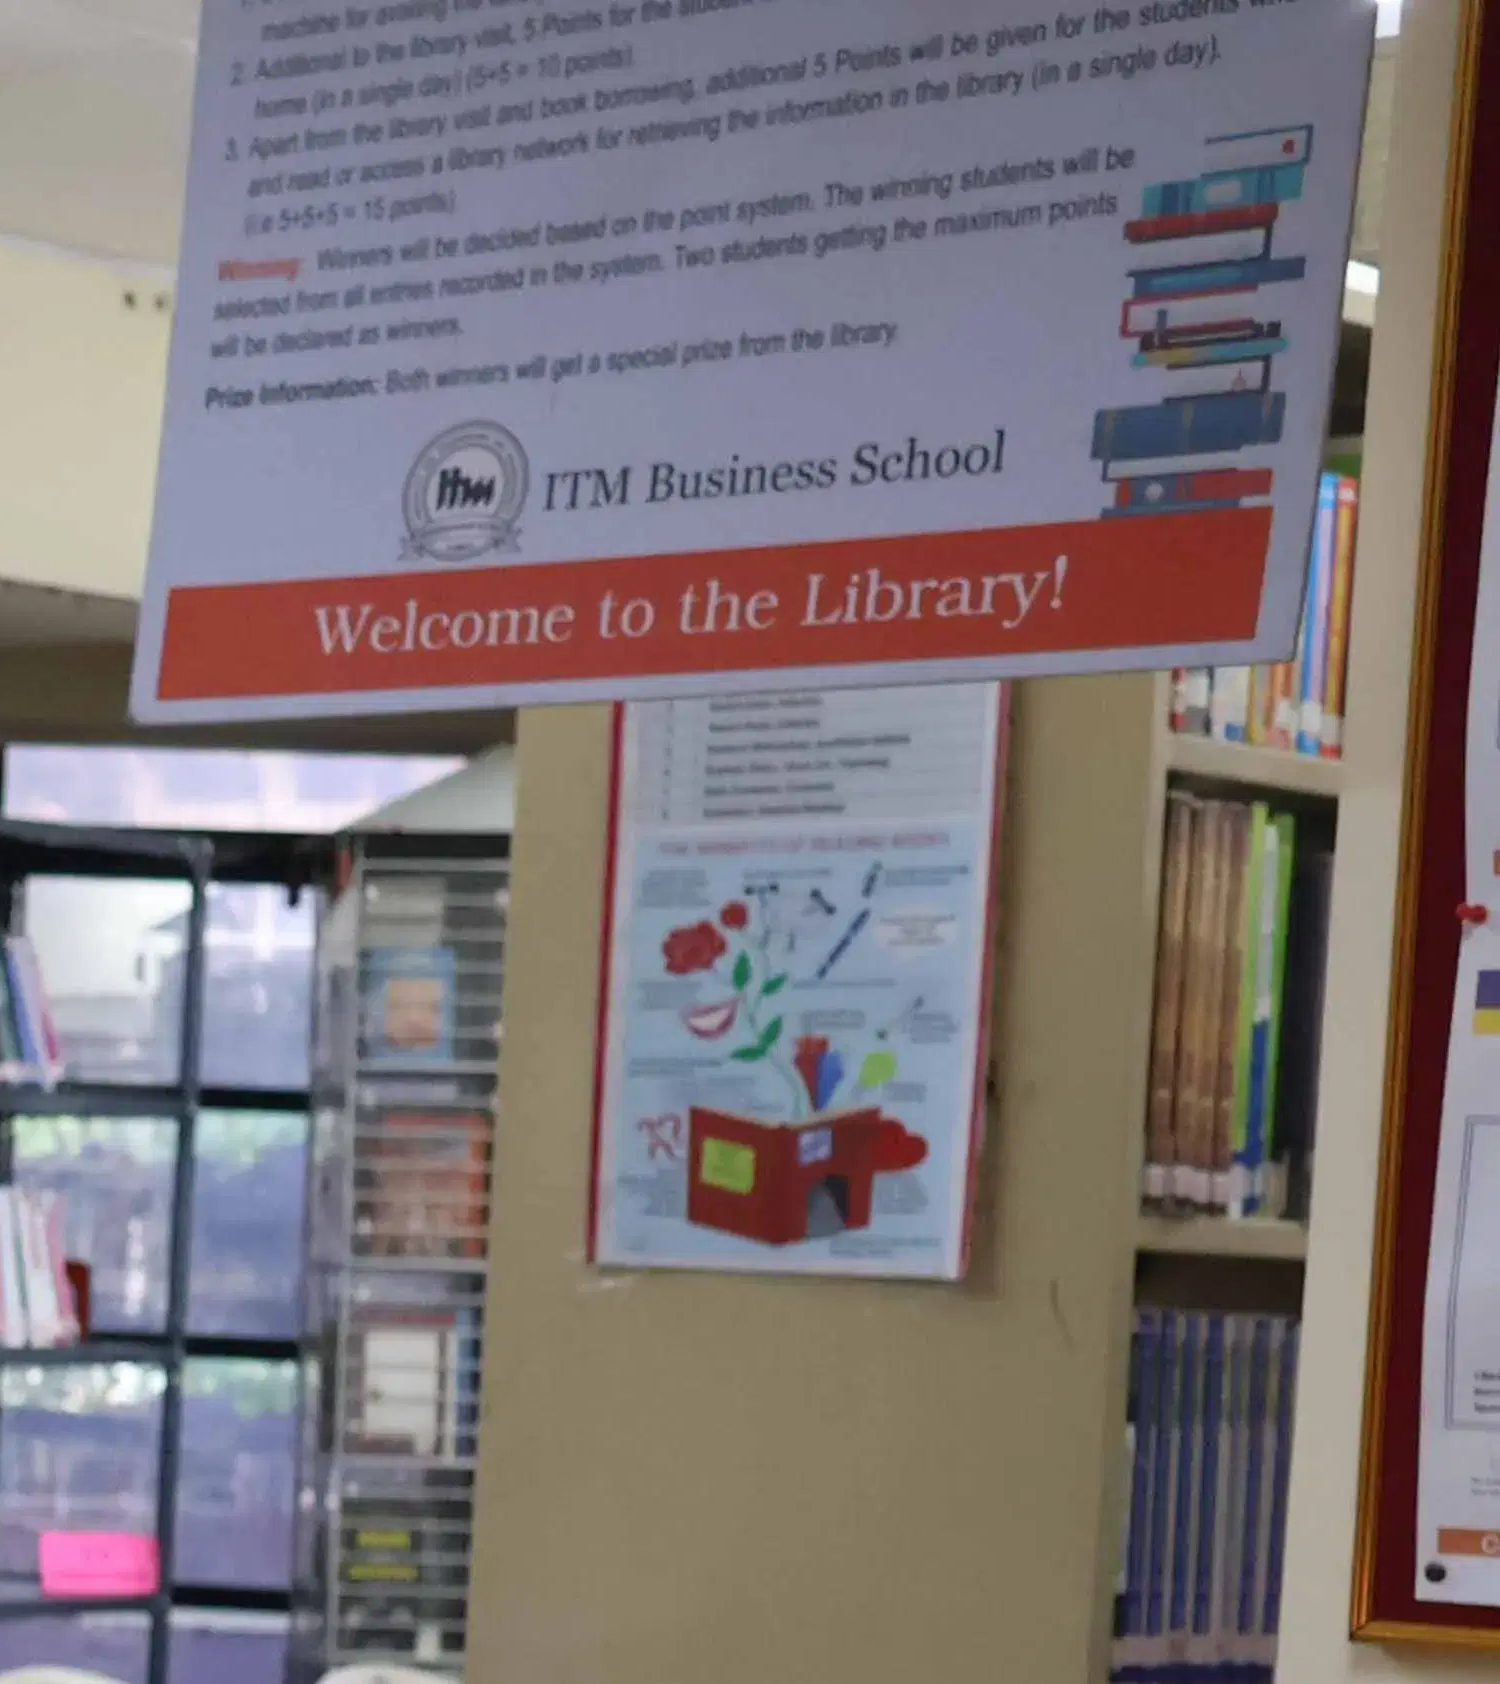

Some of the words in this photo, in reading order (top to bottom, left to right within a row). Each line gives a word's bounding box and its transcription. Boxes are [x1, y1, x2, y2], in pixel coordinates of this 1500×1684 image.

[376, 41, 405, 65] the
[409, 33, 469, 61] library
[524, 17, 539, 41] 5
[609, 4, 636, 27] for
[247, 173, 283, 199] and
[335, 167, 353, 186] or
[431, 155, 443, 174] a
[447, 144, 506, 173] library
[513, 131, 589, 162] network
[594, 126, 622, 151] for
[628, 115, 721, 145] retrieving
[726, 107, 758, 132] the
[765, 89, 884, 126] information
[888, 85, 909, 108] in
[915, 77, 950, 104] the
[956, 69, 1024, 98] library
[1031, 59, 1061, 92] (in
[1066, 60, 1082, 83] a
[1088, 46, 1157, 80] single
[248, 132, 299, 160] Apart
[305, 127, 347, 151] from
[352, 121, 385, 145] the
[388, 114, 447, 141] library
[453, 104, 492, 131] visit
[495, 99, 534, 125] and
[539, 92, 589, 120] book
[706, 57, 807, 95] additional
[813, 52, 827, 78] 5
[835, 45, 902, 74] Points
[909, 33, 944, 61] will
[951, 30, 979, 57] be
[986, 22, 1047, 57] given
[1055, 12, 1086, 40] for
[1093, 6, 1131, 35] the
[316, 244, 393, 271] Winners
[399, 237, 430, 262] will
[434, 235, 459, 259] be
[464, 223, 541, 256] decided
[545, 215, 606, 245] based
[611, 214, 638, 237] on
[643, 207, 675, 233] the
[679, 200, 731, 232] point
[823, 181, 864, 208] The
[870, 169, 953, 203] winning
[958, 157, 1056, 192] students
[1061, 148, 1099, 175] will
[1104, 144, 1136, 170] be
[363, 196, 386, 222] 15
[212, 296, 292, 320] selected
[296, 290, 339, 313] from
[369, 279, 434, 302] entries
[438, 267, 525, 296] recorded
[529, 264, 549, 286] in
[553, 259, 584, 283] the
[674, 244, 716, 270] Two
[720, 232, 808, 265] students
[813, 221, 887, 258] getting
[892, 216, 928, 242] the
[933, 203, 1043, 235] maximum
[1047, 191, 1118, 226] points
[204, 385, 255, 411] Prize
[385, 368, 431, 394] Both
[434, 363, 510, 388] winners
[515, 355, 548, 380] will
[550, 351, 584, 383] get
[587, 355, 602, 374] a
[605, 342, 678, 374] special
[681, 337, 733, 368] prize
[738, 328, 786, 357] from
[791, 327, 825, 352] the
[210, 335, 239, 358] will
[243, 334, 267, 356] be
[271, 325, 354, 353] declared
[357, 325, 381, 344] as
[542, 466, 632, 512] ITM
[646, 454, 838, 505] Business
[849, 428, 1007, 484] School
[313, 598, 574, 656] Welcome
[599, 590, 655, 640] to
[679, 577, 779, 634] the
[801, 556, 1069, 632] Library!
